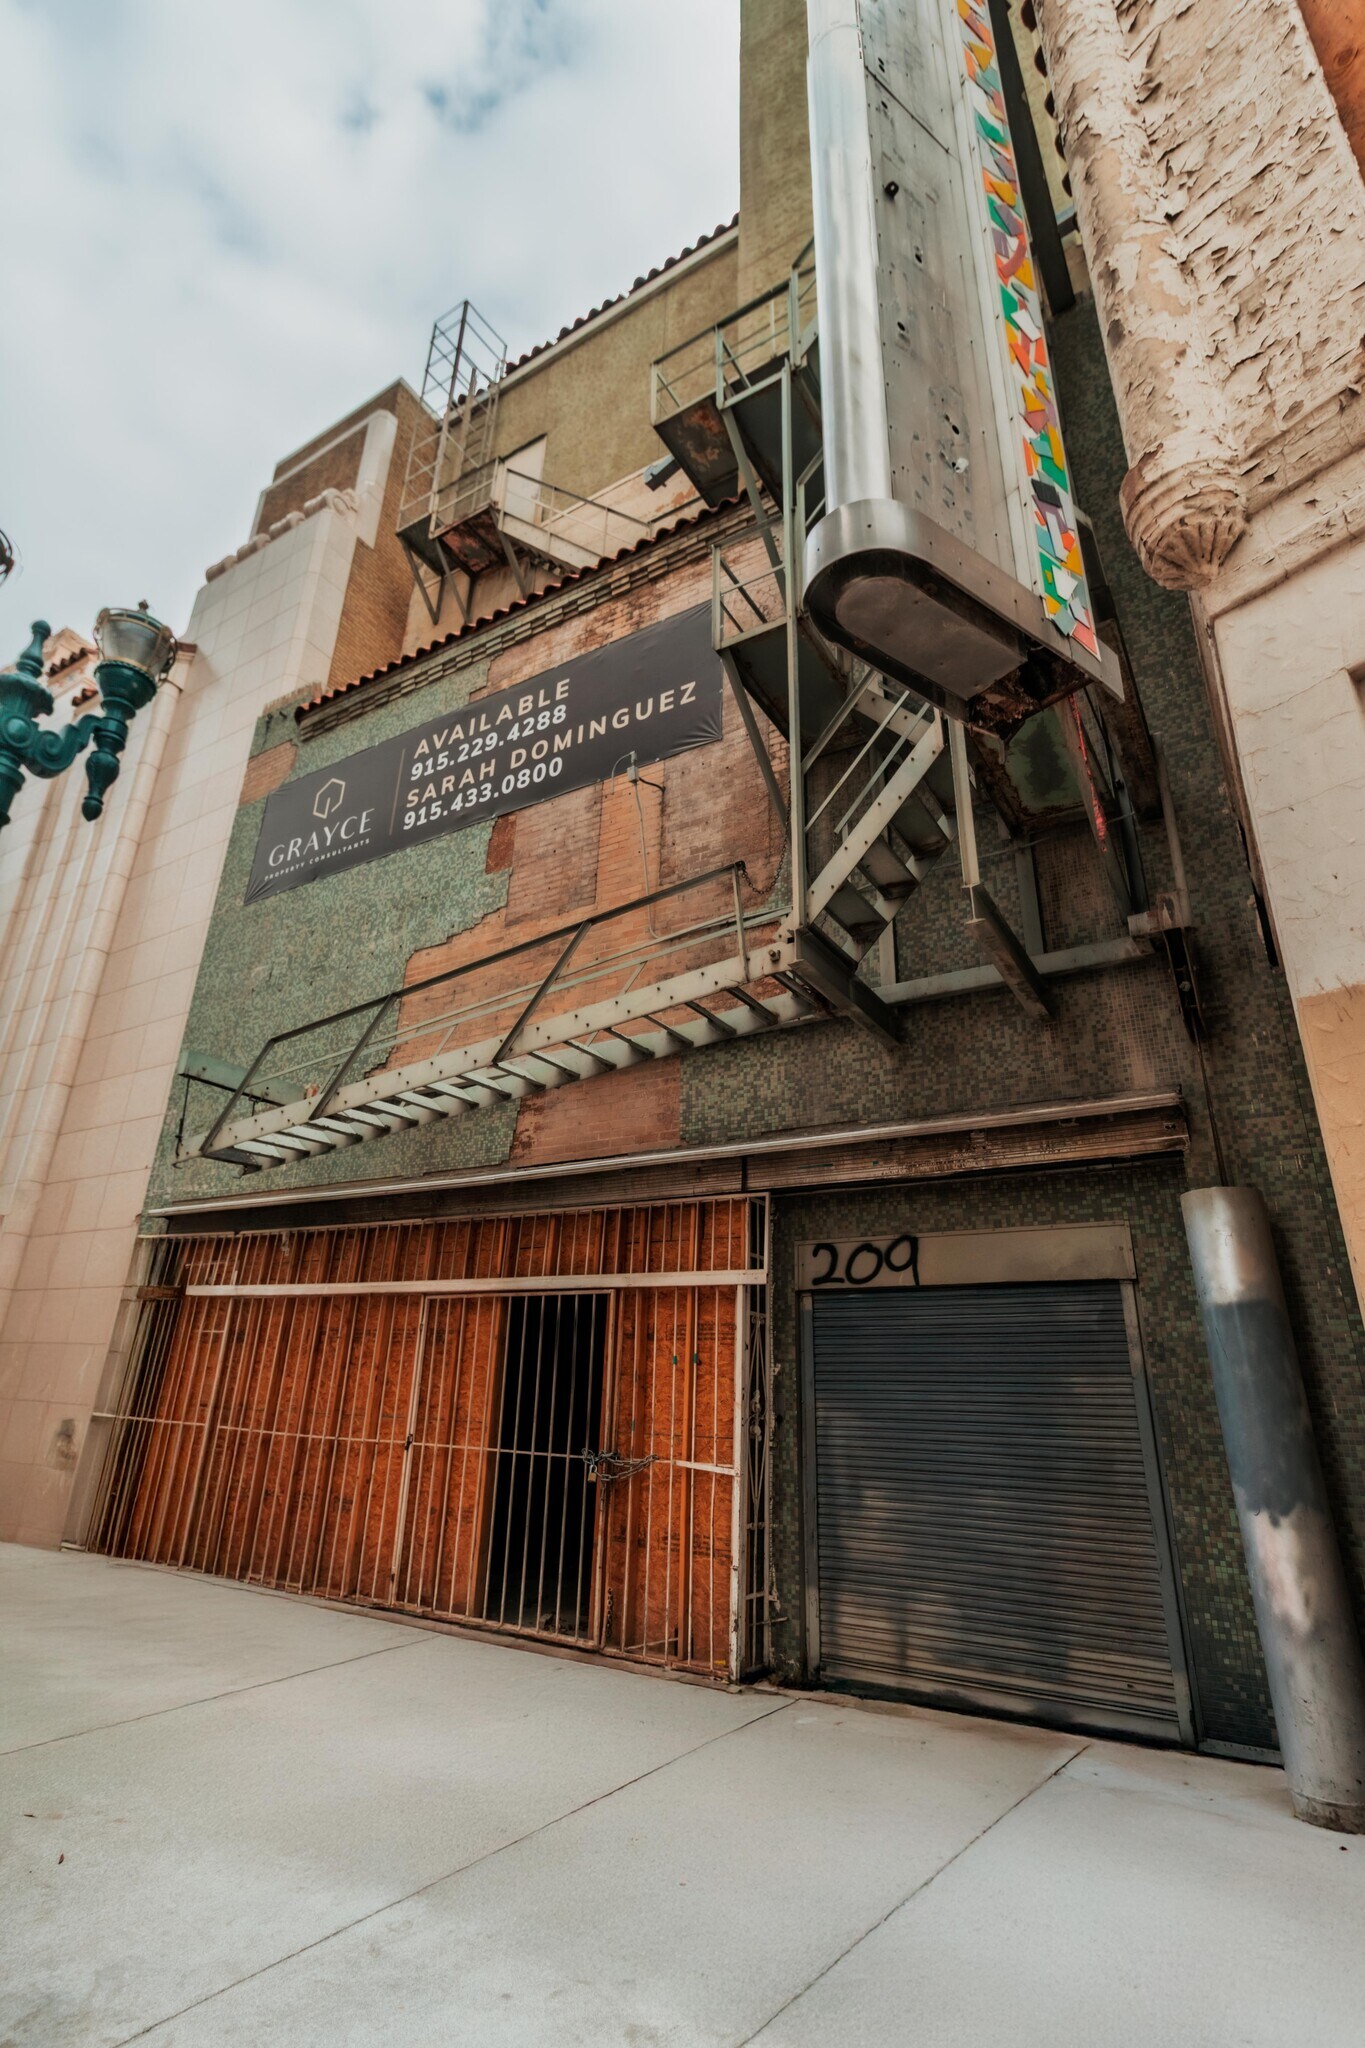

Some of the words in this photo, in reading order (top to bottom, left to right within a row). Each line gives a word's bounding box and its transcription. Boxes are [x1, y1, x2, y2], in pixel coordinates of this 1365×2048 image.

[406, 759, 496, 808] SARAH
[510, 681, 697, 769] DOMINGUEZ
[410, 704, 567, 781] 915.229.4288
[414, 678, 570, 759] AVAILABLE
[403, 757, 563, 830] 915.433.0800
[264, 862, 306, 881] PROPERTY
[309, 838, 370, 865] CONSULTANTS
[268, 808, 375, 867] GRAYCE
[812, 1234, 920, 1288] 209
